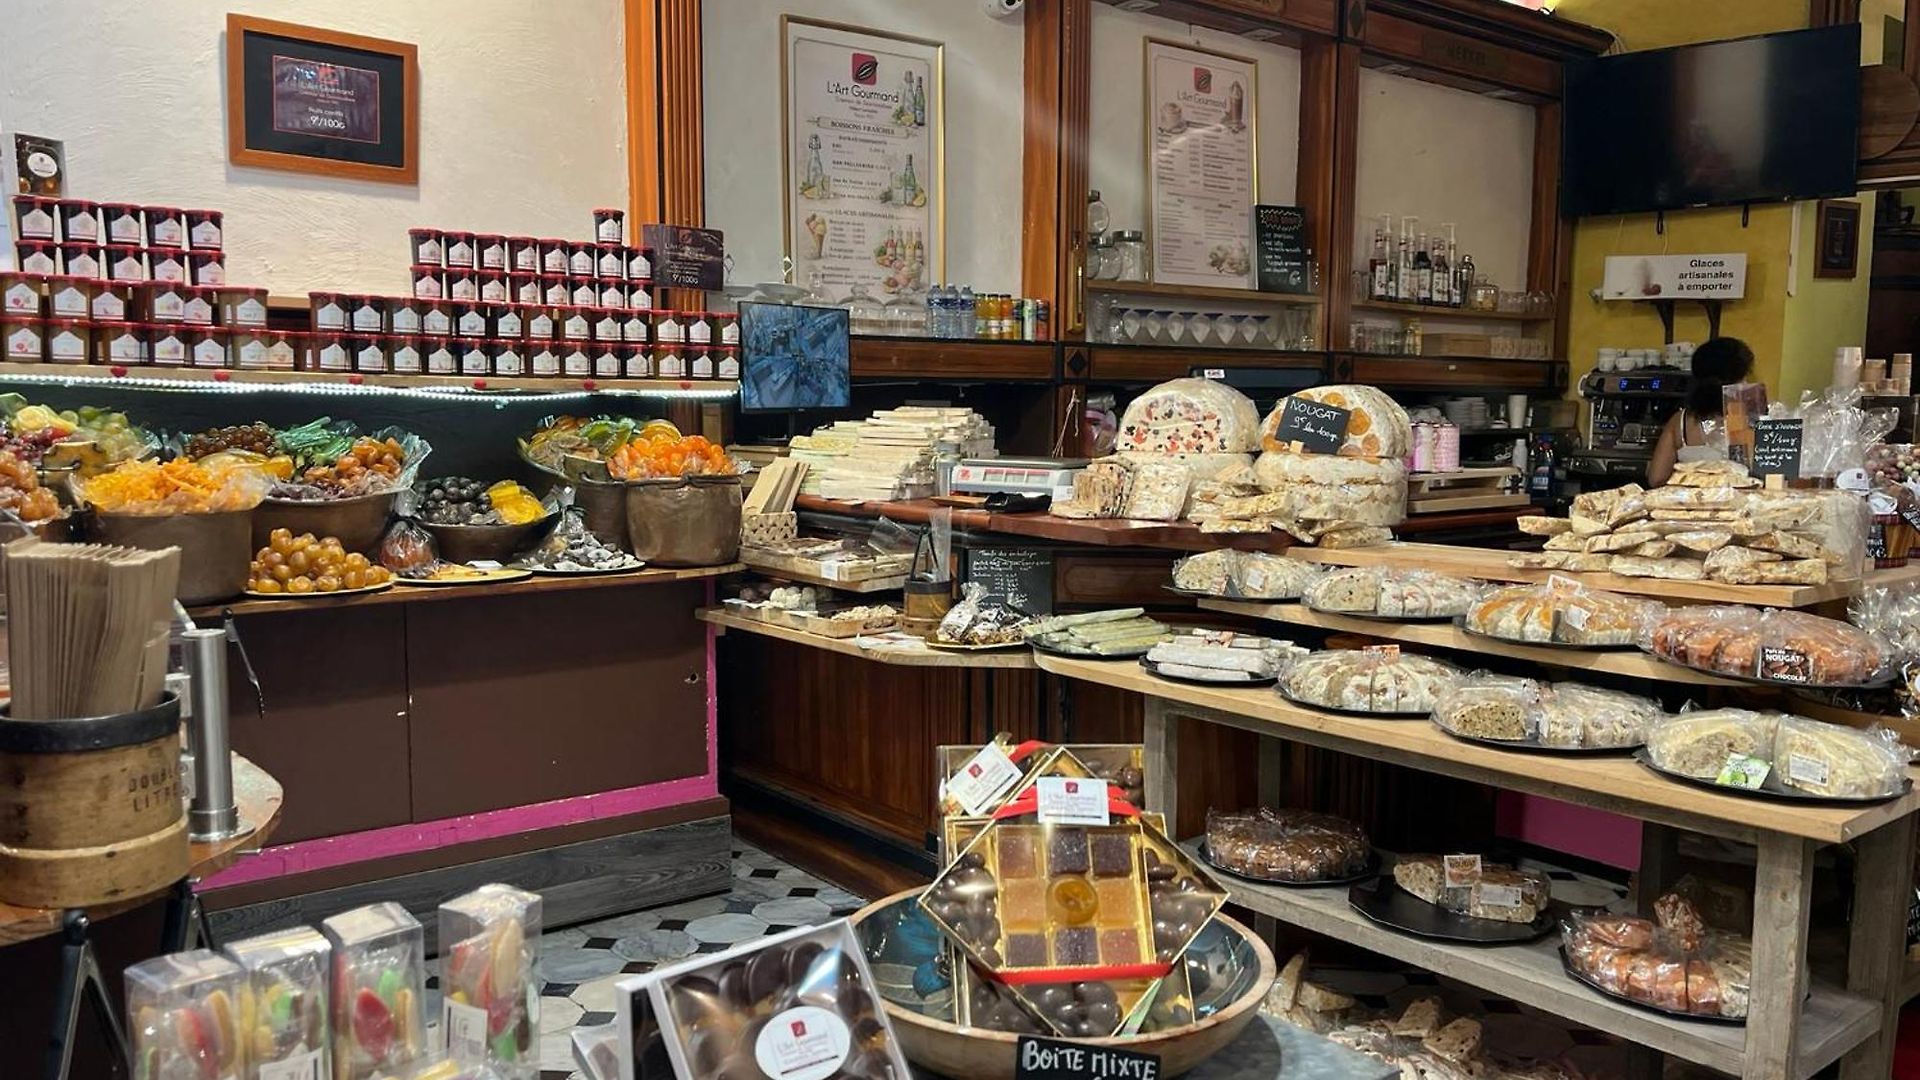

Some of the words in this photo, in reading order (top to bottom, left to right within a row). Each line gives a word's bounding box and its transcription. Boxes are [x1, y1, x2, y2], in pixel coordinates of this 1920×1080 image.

[827, 81, 849, 96] L'Art
[851, 84, 899, 103] Gourmand
[1690, 259, 1725, 268] Glaces
[1678, 270, 1734, 280] artisanales
[1678, 283, 1685, 291] à
[1686, 283, 1733, 292] emporter
[1290, 400, 1342, 421] NOUGAT
[1765, 654, 1800, 663] NOUGAT
